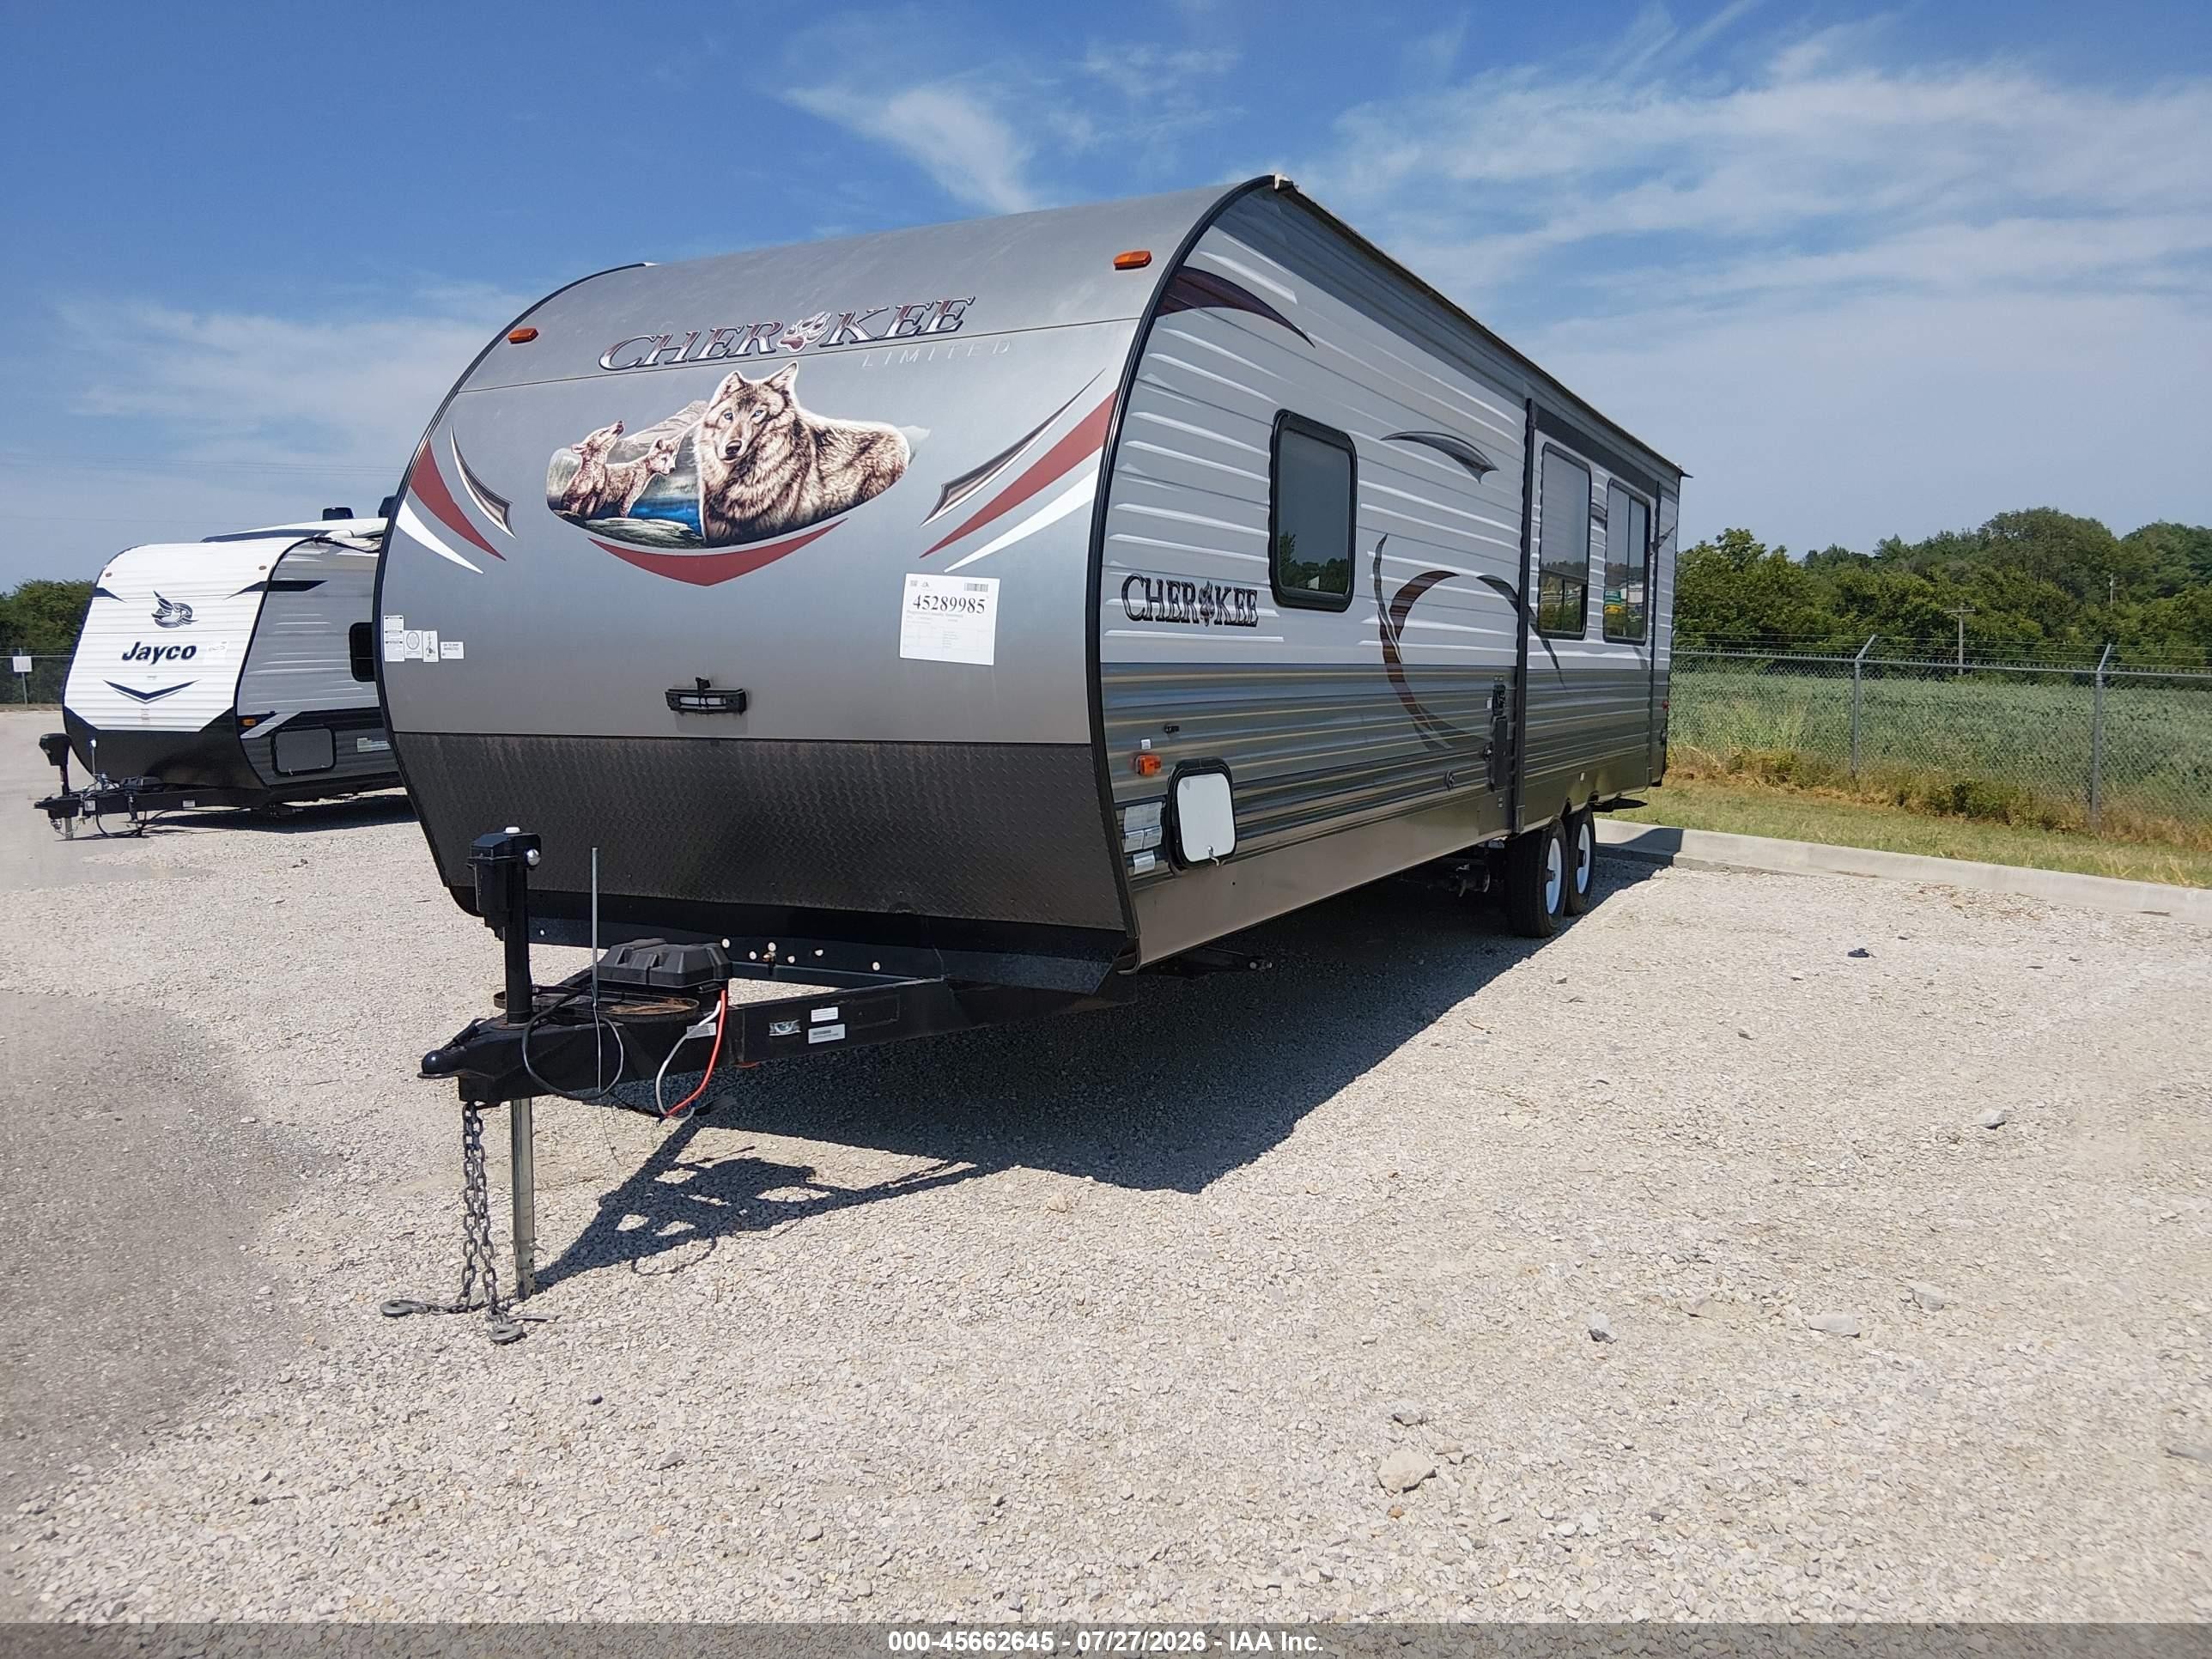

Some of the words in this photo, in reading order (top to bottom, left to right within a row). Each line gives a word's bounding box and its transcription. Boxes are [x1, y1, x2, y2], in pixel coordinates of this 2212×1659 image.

[861, 337, 1012, 368] LIMITED
[913, 594, 986, 614] 45289985
[121, 641, 198, 665] Jayco
